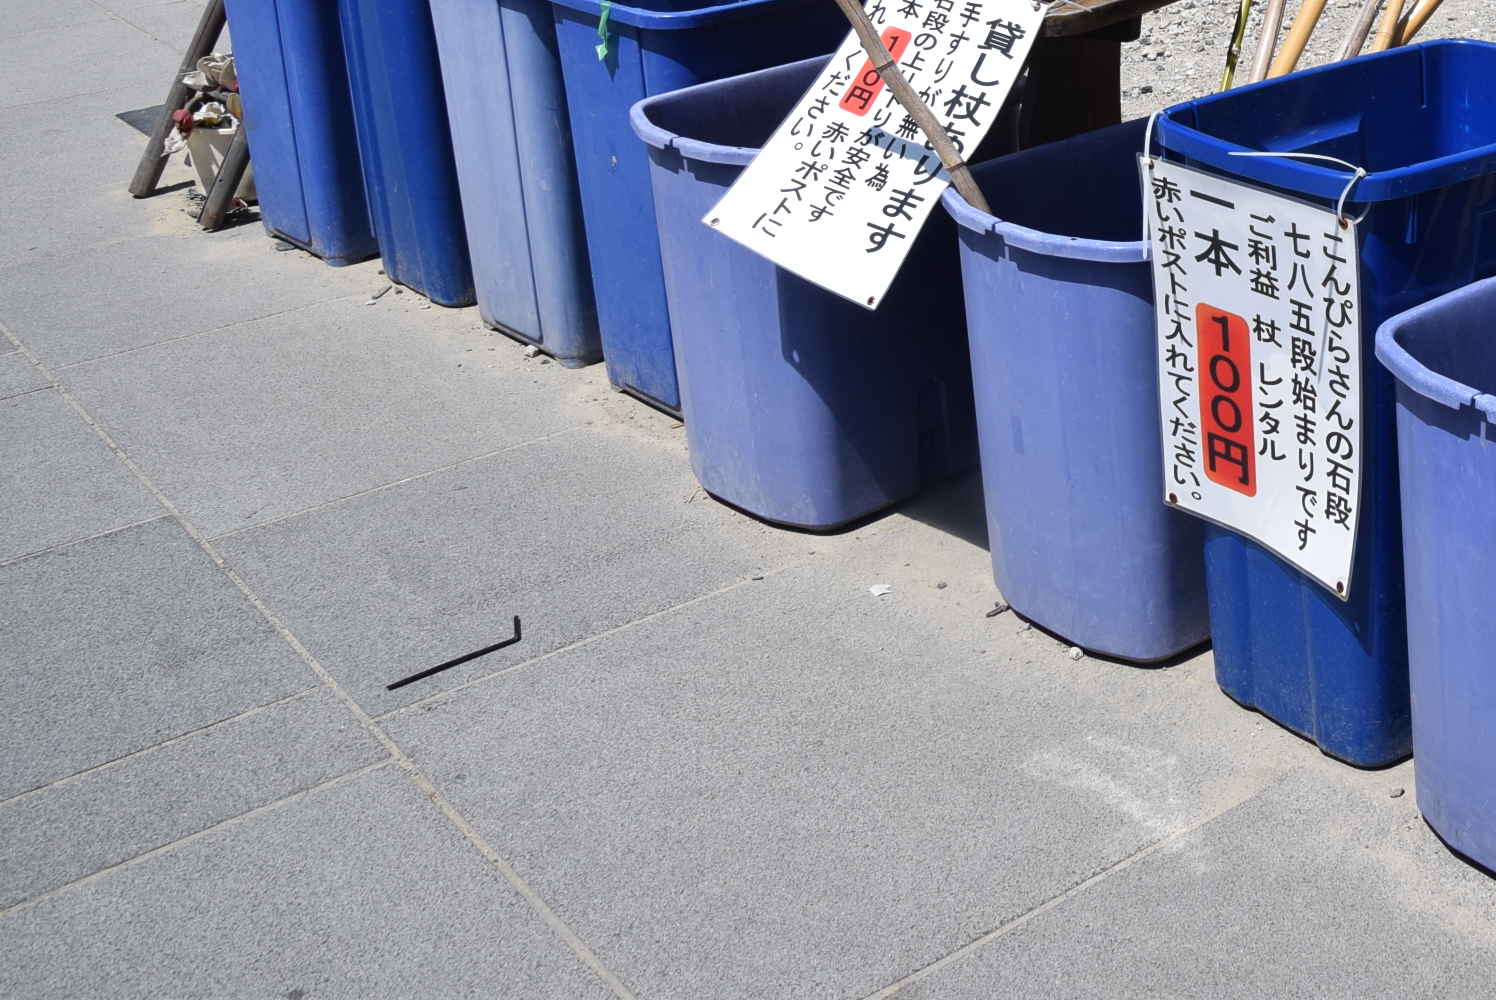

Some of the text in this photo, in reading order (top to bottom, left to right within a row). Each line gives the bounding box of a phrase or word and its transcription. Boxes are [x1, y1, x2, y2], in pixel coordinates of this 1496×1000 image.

[752, 121, 850, 238] 赤いポストに
[844, 34, 900, 110] 10円
[1151, 176, 1202, 501] 赤いポストに入れてください。
[1189, 189, 1250, 487] 一本 100円
[1247, 213, 1286, 461] ご利益 杖 レンタル
[1283, 222, 1318, 551] 七八五段始まりです
[1321, 232, 1355, 531] こんぴらさんの石段
